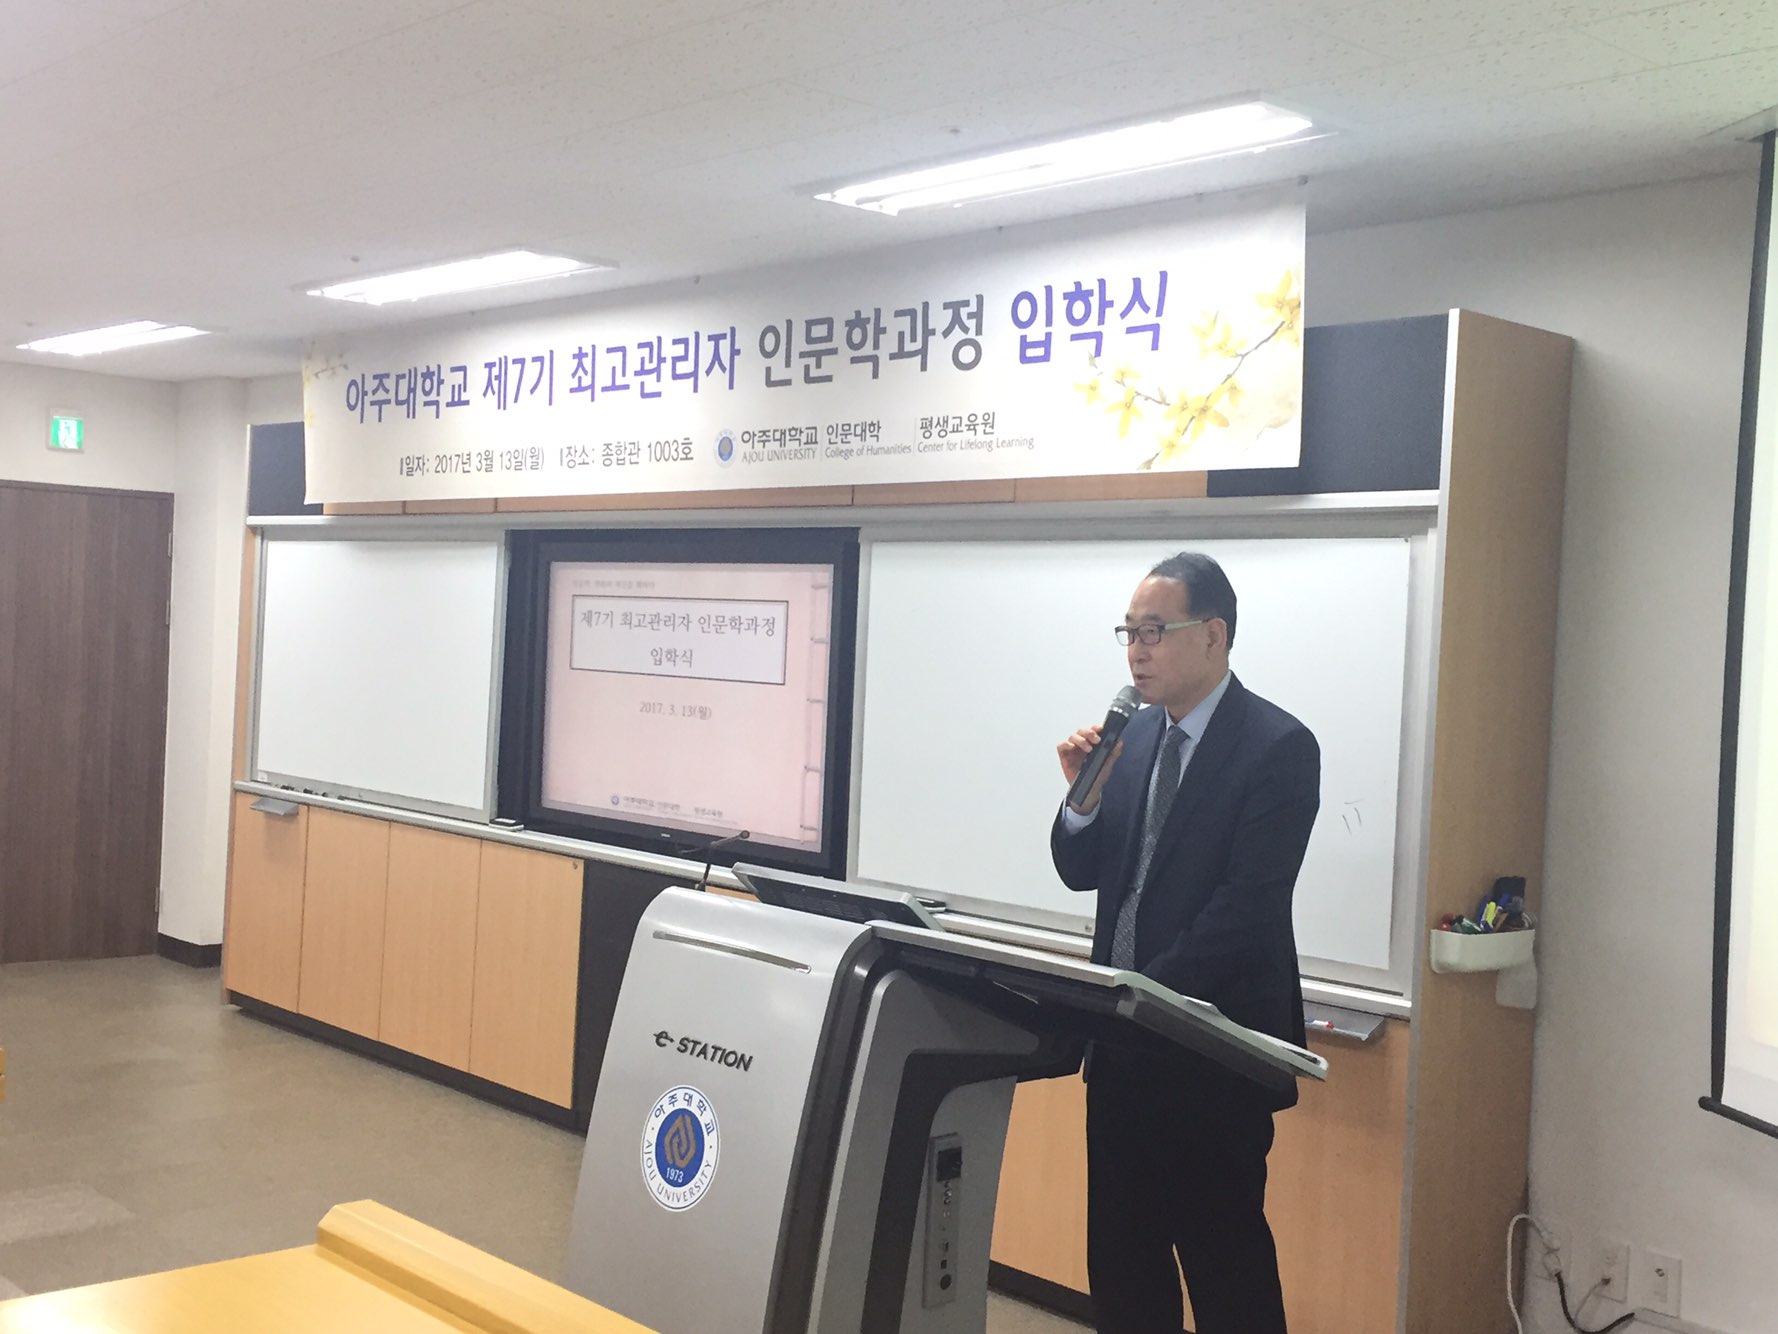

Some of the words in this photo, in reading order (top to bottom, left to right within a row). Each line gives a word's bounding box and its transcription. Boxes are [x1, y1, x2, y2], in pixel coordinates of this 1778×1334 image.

[346, 364, 470, 424] 아주대학교
[482, 349, 555, 411] 제7기
[569, 326, 741, 402] 최고관리자
[759, 293, 985, 388] 인문학과정
[1010, 270, 1169, 365] 입학식
[741, 426, 818, 449] 아주대학교
[826, 420, 881, 445] 인문대학
[919, 411, 995, 440] 평생교육원
[434, 451, 472, 474] 2017년
[476, 449, 494, 472] 3월
[499, 446, 545, 471] 13일(월)
[565, 444, 595, 469] 장소:
[601, 440, 641, 467] 종합관
[648, 437, 694, 462] 1003호
[742, 450, 765, 464] AJOU
[767, 447, 817, 461] UNIVERSITY
[825, 445, 854, 460] College
[856, 444, 865, 456] of
[866, 443, 911, 456] Humanities
[917, 441, 944, 453] Center
[946, 439, 959, 451] for
[960, 438, 993, 452] Lifelong
[996, 437, 1035, 450] Learning
[580, 609, 614, 629] 제7기
[619, 611, 692, 632] 최고관리자
[697, 614, 777, 637] 인문학과정
[650, 647, 694, 668] 입학식
[681, 703, 712, 721] 13(월)
[654, 1092, 715, 1136] 아주대학교
[643, 1139, 657, 1181] AJOU
[656, 1160, 712, 1203] UNIVERSITY
[666, 1167, 684, 1182] 1973
